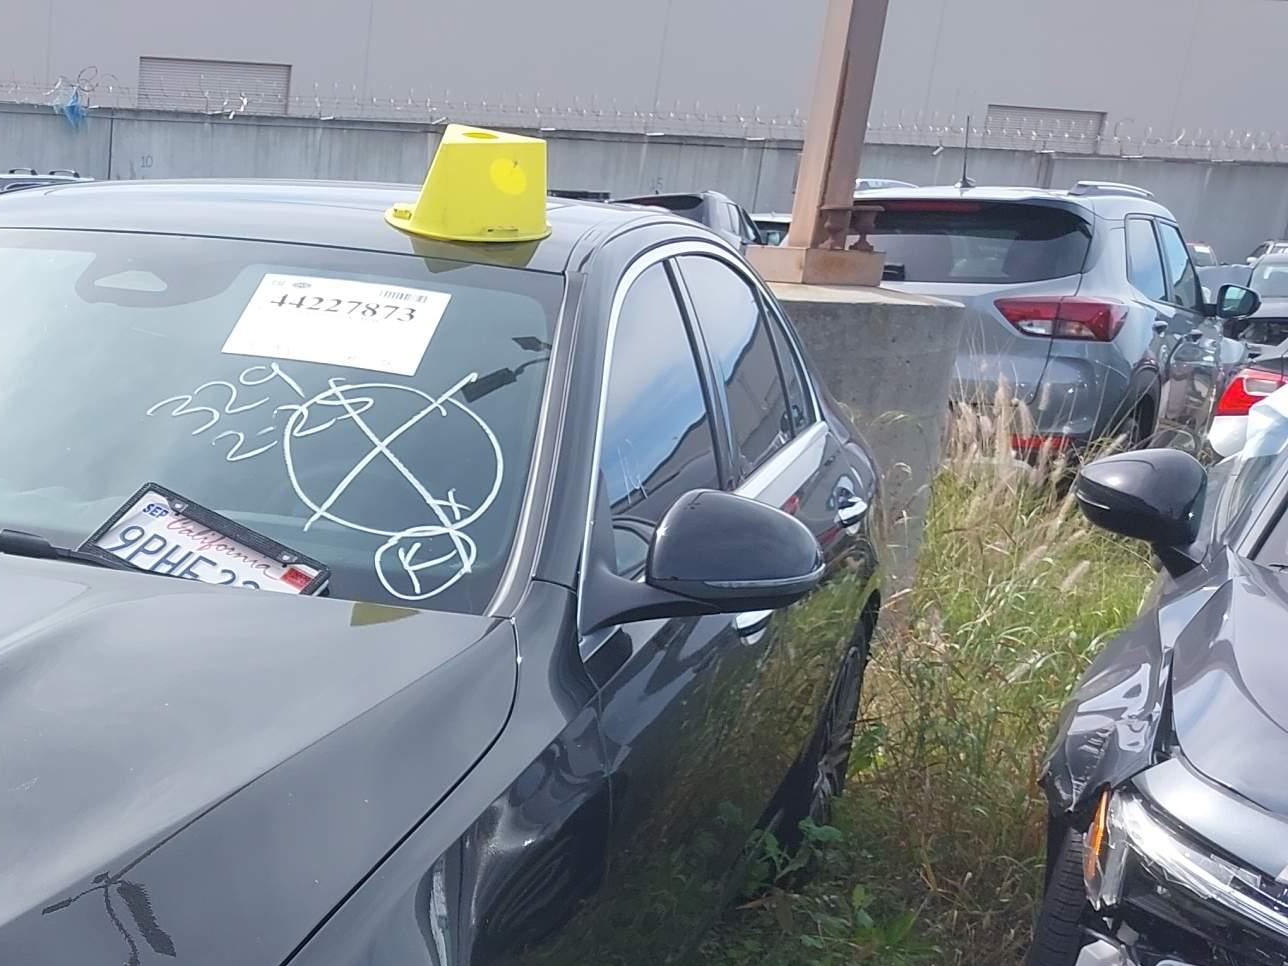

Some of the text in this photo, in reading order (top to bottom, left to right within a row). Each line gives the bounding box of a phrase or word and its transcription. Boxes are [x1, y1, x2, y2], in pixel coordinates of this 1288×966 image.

[270, 293, 417, 322] 44227873
[146, 362, 306, 436] 329
[142, 503, 169, 519] SEP
[166, 516, 278, 581] California
